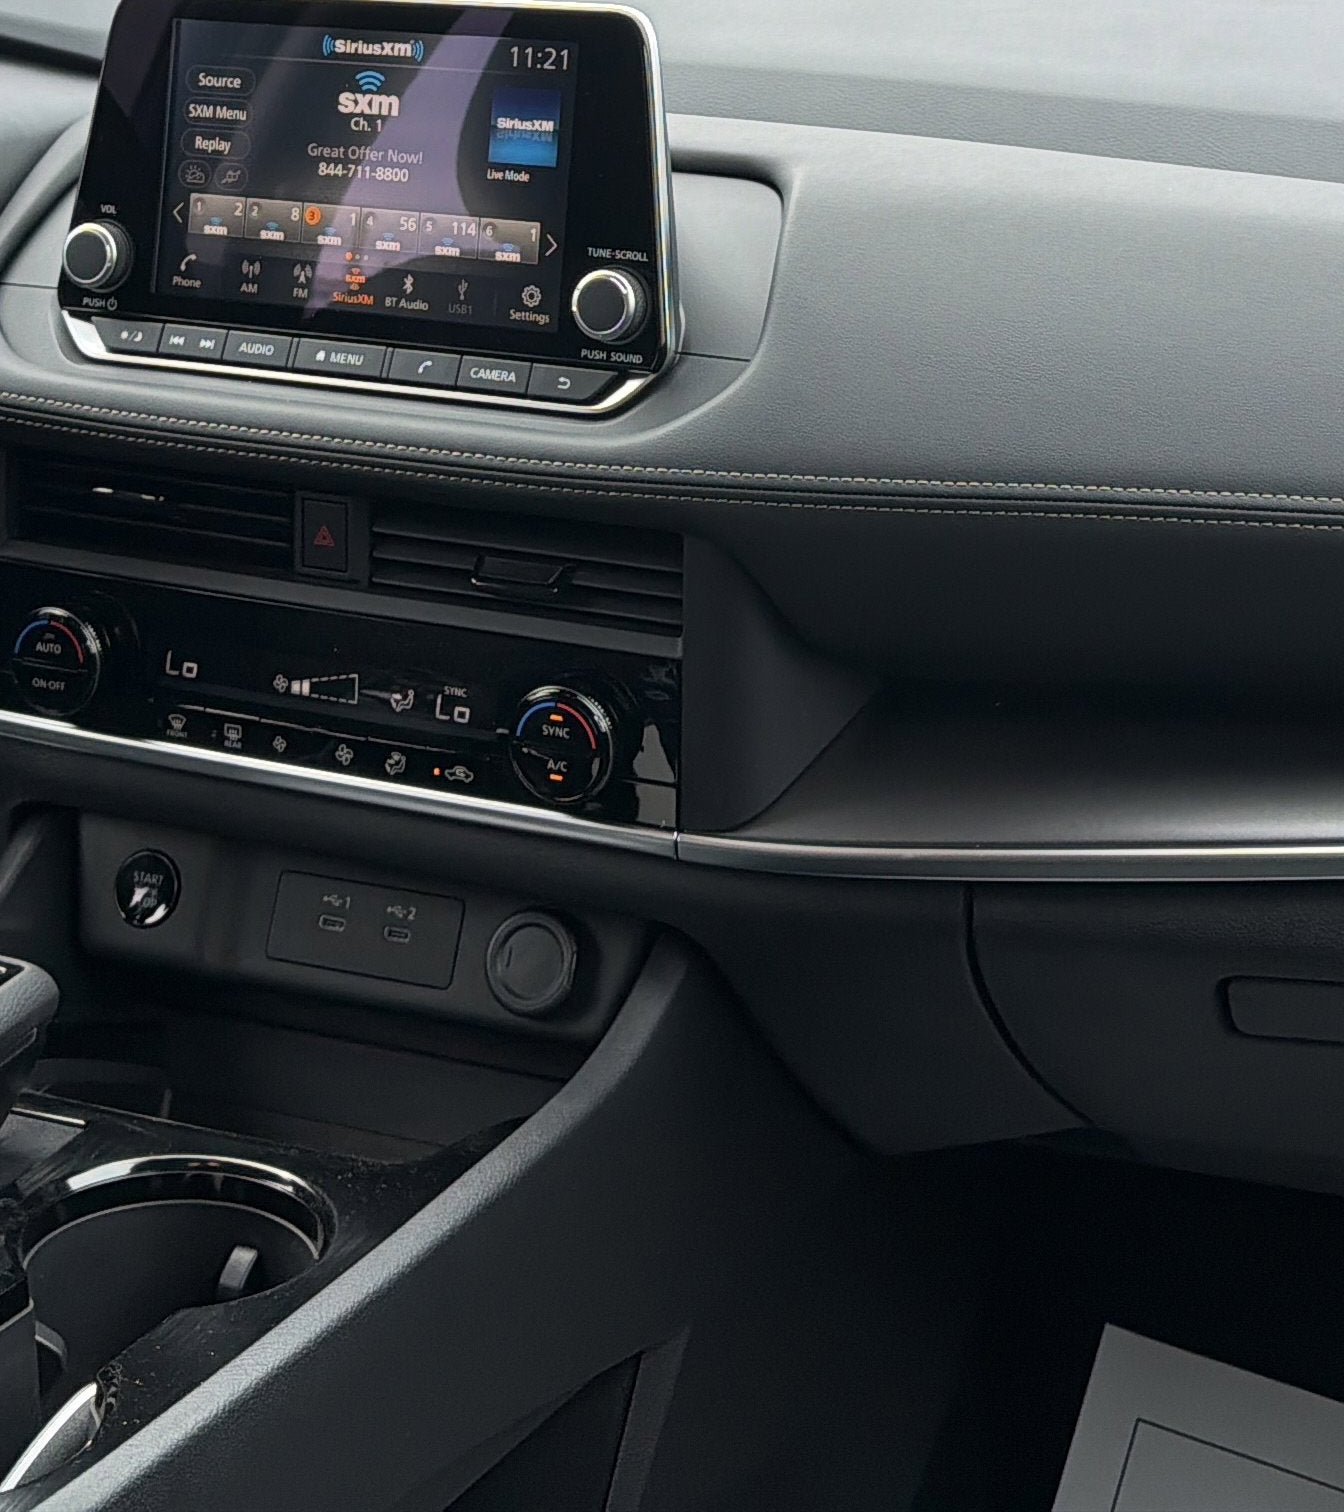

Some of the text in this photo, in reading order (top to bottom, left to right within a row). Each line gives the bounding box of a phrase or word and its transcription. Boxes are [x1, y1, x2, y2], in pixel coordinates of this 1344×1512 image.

[510, 46, 569, 70] 11:21
[198, 73, 242, 89] Source
[338, 91, 399, 117] sxm
[189, 104, 247, 121] SXM Menu
[351, 117, 382, 132] Ch. 1
[497, 118, 554, 132] SiriusXM
[195, 136, 231, 154] Replay
[308, 143, 423, 165] Great Offer Now!
[318, 162, 409, 182] 844-711-8800
[487, 168, 530, 182] Live Mode
[101, 204, 117, 214] VOL
[233, 202, 243, 217] 2
[291, 207, 300, 221] 8
[350, 212, 355, 226] 1
[399, 216, 417, 232] 56
[452, 221, 476, 236] 114
[530, 228, 536, 242] 1
[172, 276, 202, 288] Phone
[240, 283, 258, 294] AM
[293, 287, 308, 298] FM
[333, 291, 374, 305] SiriusXM
[82, 297, 105, 308] PUSH
[385, 297, 429, 311] BT Audio
[448, 303, 473, 315] USB1
[509, 309, 550, 326] Settings
[239, 342, 275, 356] AUDIO
[581, 349, 643, 364] PUSH SOUND
[329, 351, 364, 366] MENU
[470, 367, 516, 383] CAMERA
[36, 641, 62, 655] AUTO
[165, 650, 198, 678] Lo
[443, 686, 468, 698] SYNC
[435, 694, 470, 724] Lo
[542, 724, 570, 739] SYNC
[224, 740, 242, 749] REAR
[547, 759, 568, 773] A/C
[134, 870, 163, 885] START
